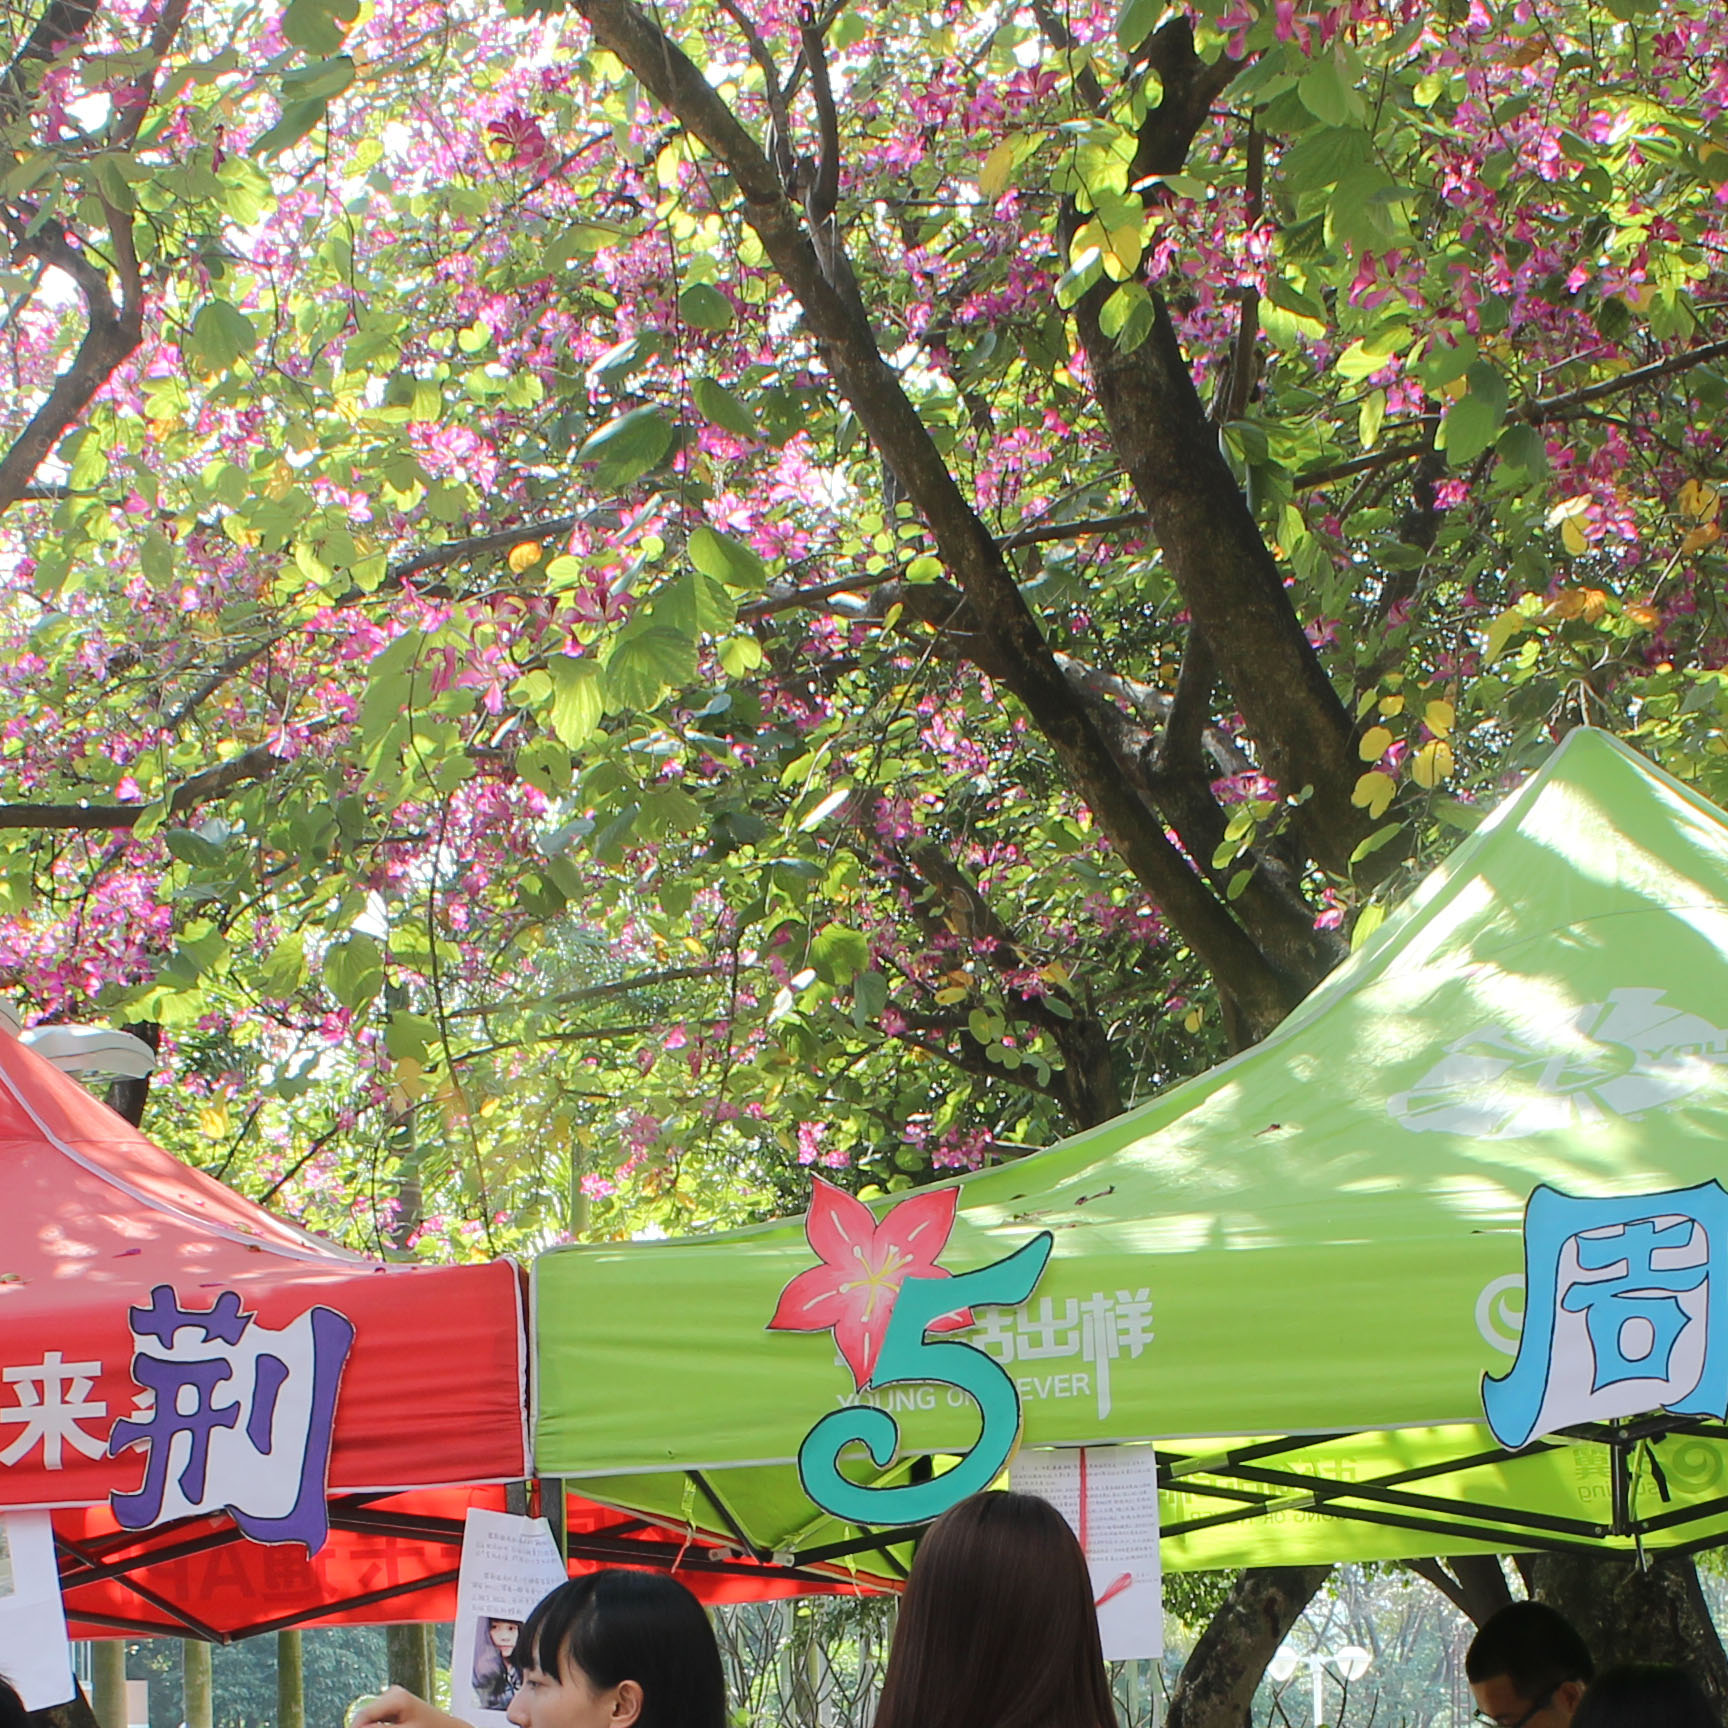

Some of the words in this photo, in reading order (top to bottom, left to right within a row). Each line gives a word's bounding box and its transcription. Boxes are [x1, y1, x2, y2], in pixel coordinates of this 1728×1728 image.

[108, 1284, 356, 1560] 荆
[798, 1231, 1055, 1526] 5
[1017, 1372, 1091, 1401] EVER
